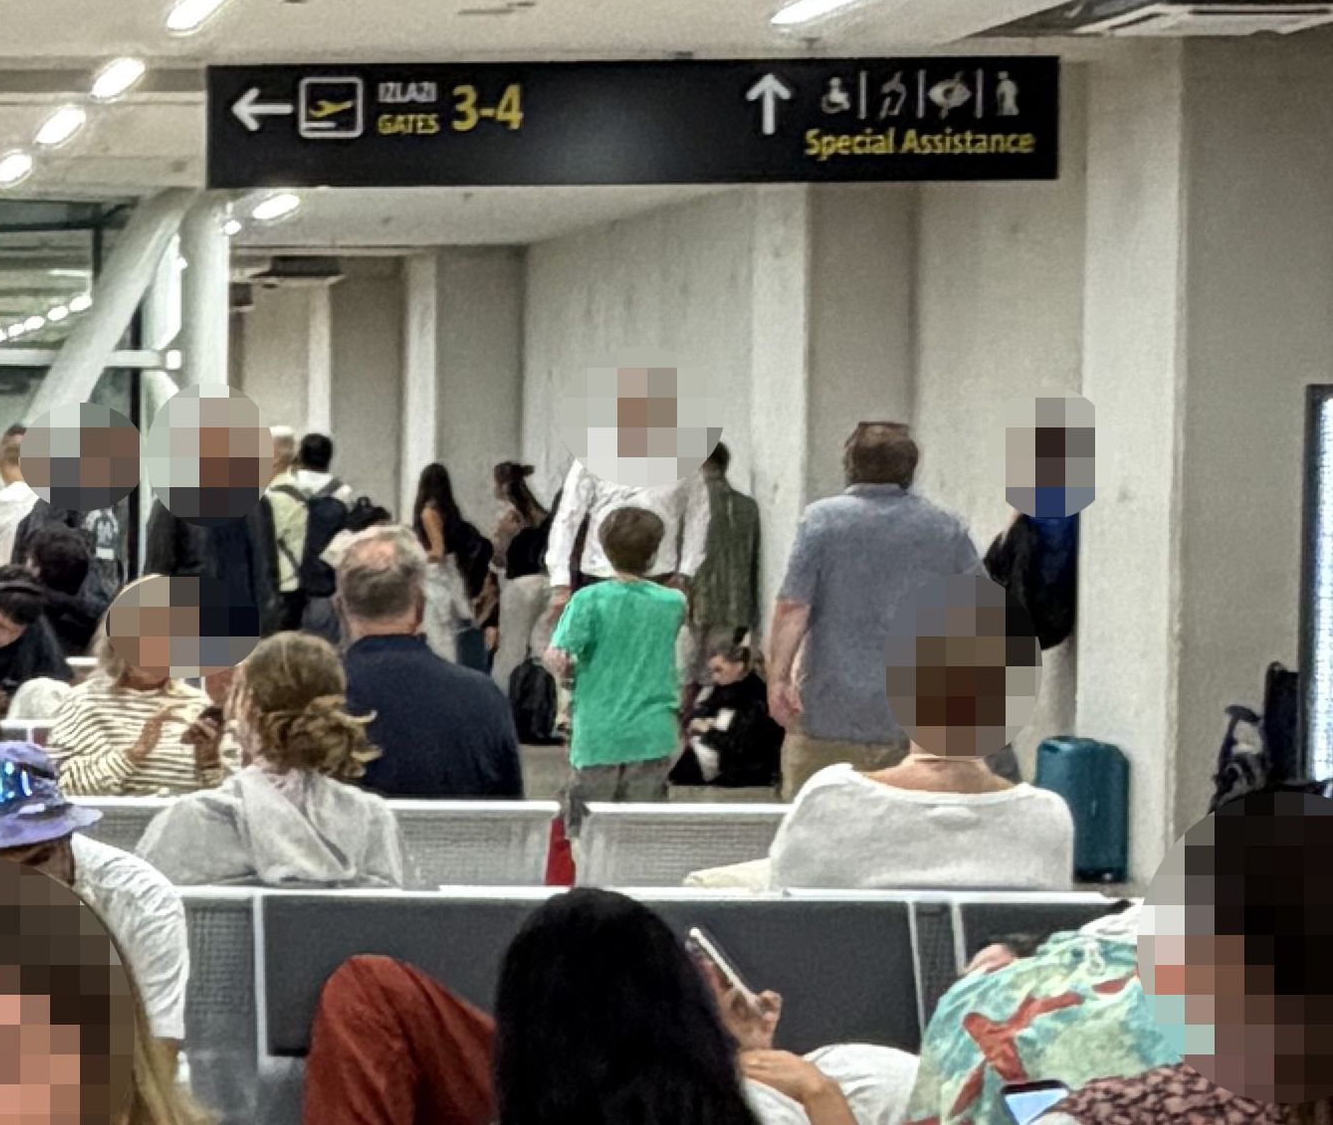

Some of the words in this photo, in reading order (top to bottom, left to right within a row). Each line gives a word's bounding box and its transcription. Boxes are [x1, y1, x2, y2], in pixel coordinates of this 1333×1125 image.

[378, 114, 440, 134] GATES
[452, 84, 524, 131] 3-4
[805, 127, 895, 161] Special
[901, 127, 1035, 155] Assistance
